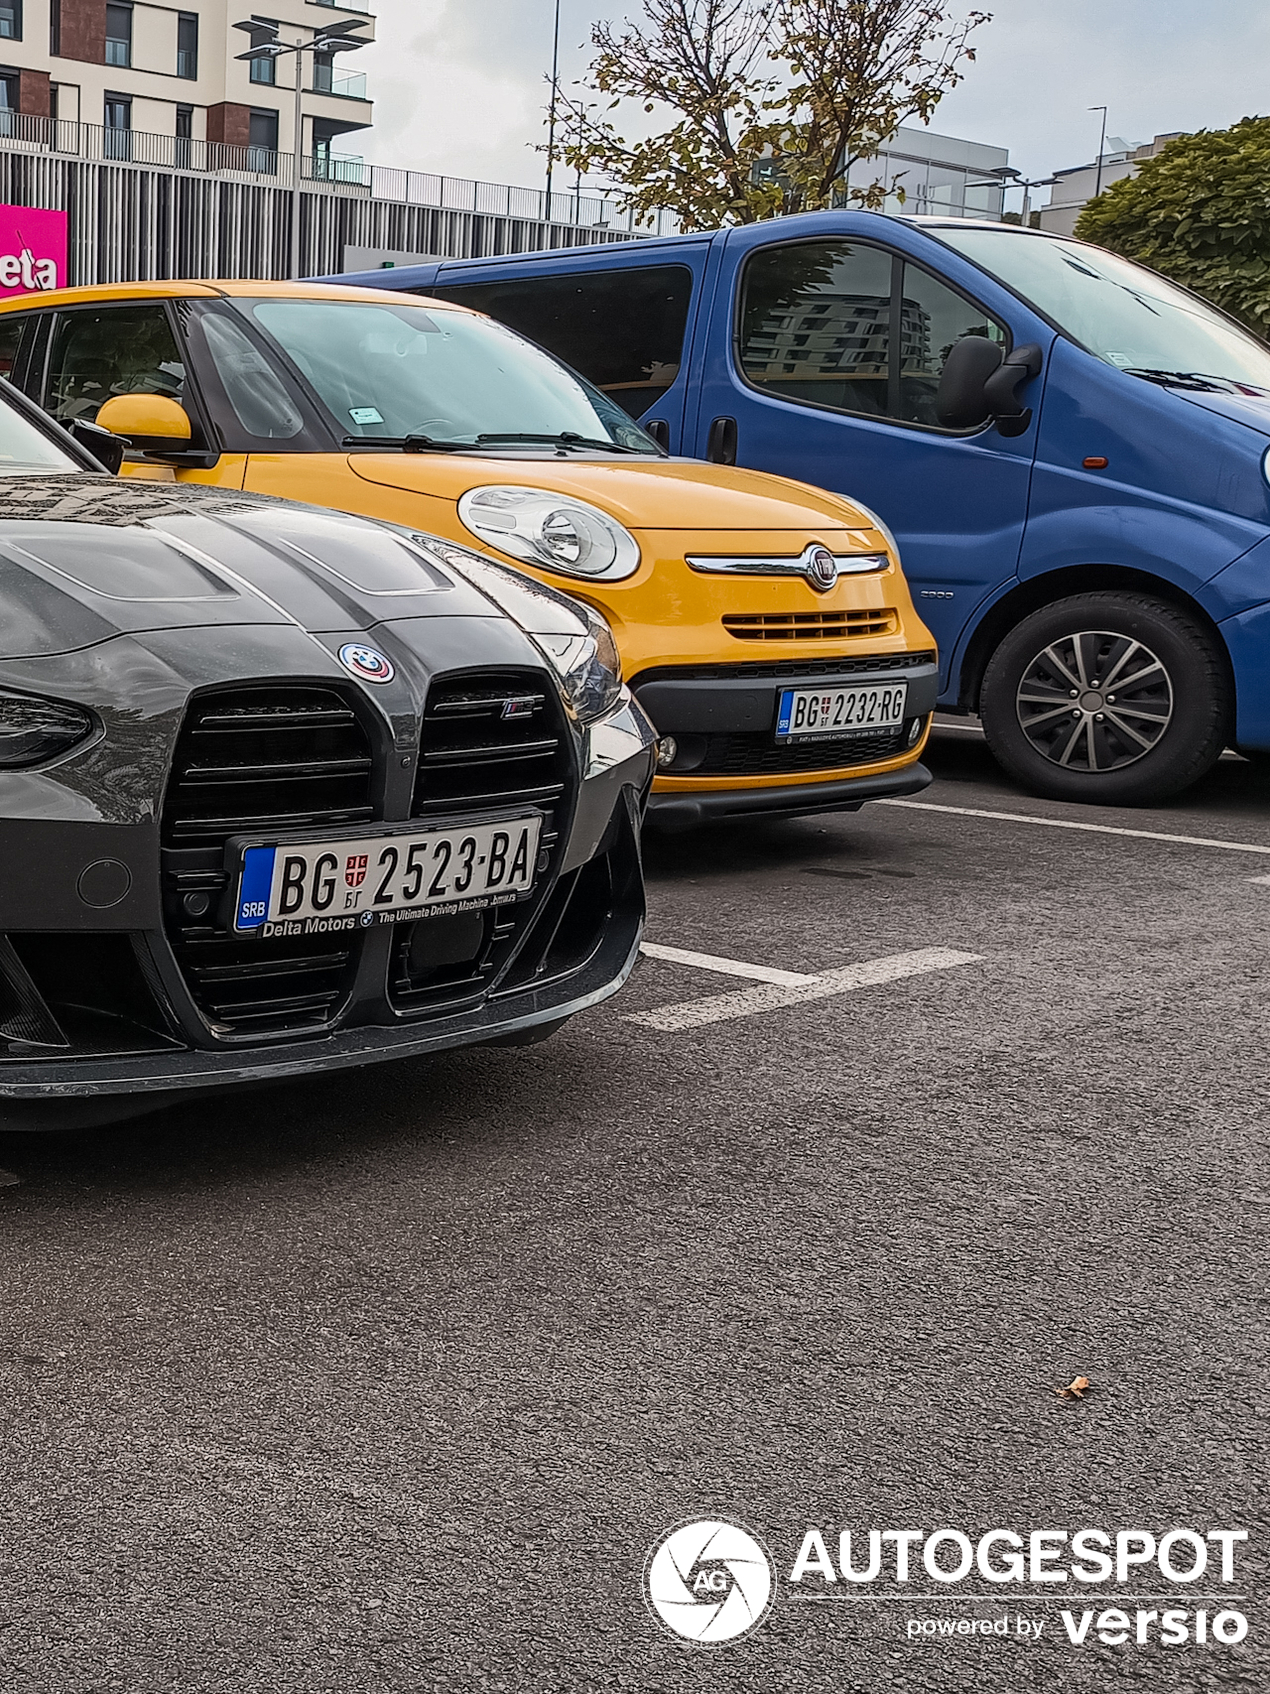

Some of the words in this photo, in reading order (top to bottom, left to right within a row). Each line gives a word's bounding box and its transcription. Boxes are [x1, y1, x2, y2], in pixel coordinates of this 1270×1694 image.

[794, 696, 820, 728] BG
[278, 852, 338, 916] BG
[373, 827, 530, 905] 2523-BA
[241, 902, 266, 918] SRB
[262, 922, 302, 938] Delta
[305, 917, 356, 933] Motors
[379, 912, 395, 923] The
[396, 908, 429, 922] Ultimate
[430, 903, 457, 916] Driving
[458, 897, 489, 911] Machine
